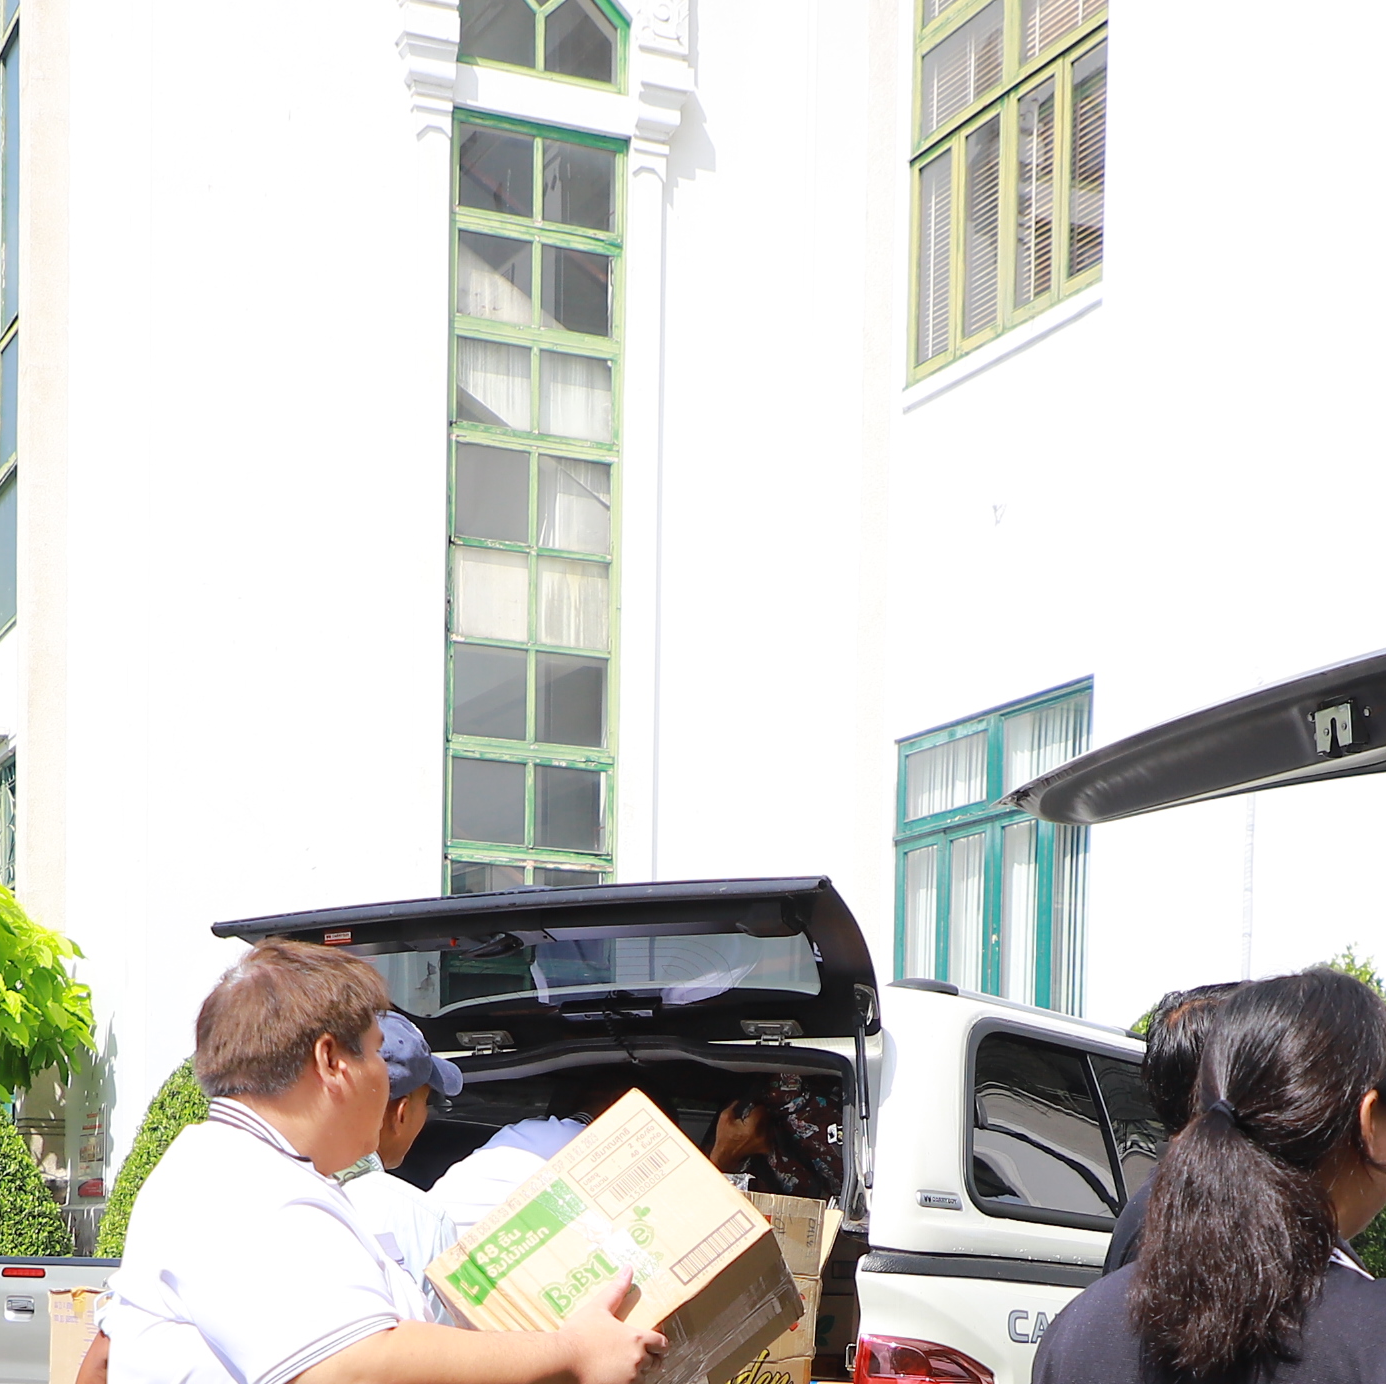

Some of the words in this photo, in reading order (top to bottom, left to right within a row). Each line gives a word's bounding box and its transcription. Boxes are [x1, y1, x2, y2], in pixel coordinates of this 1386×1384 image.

[476, 1244, 500, 1265] 48
[498, 1228, 522, 1246] ชิ้น
[486, 1226, 550, 1278] จัมโบ้แพ็ก
[1008, 1309, 1053, 1344] CA
